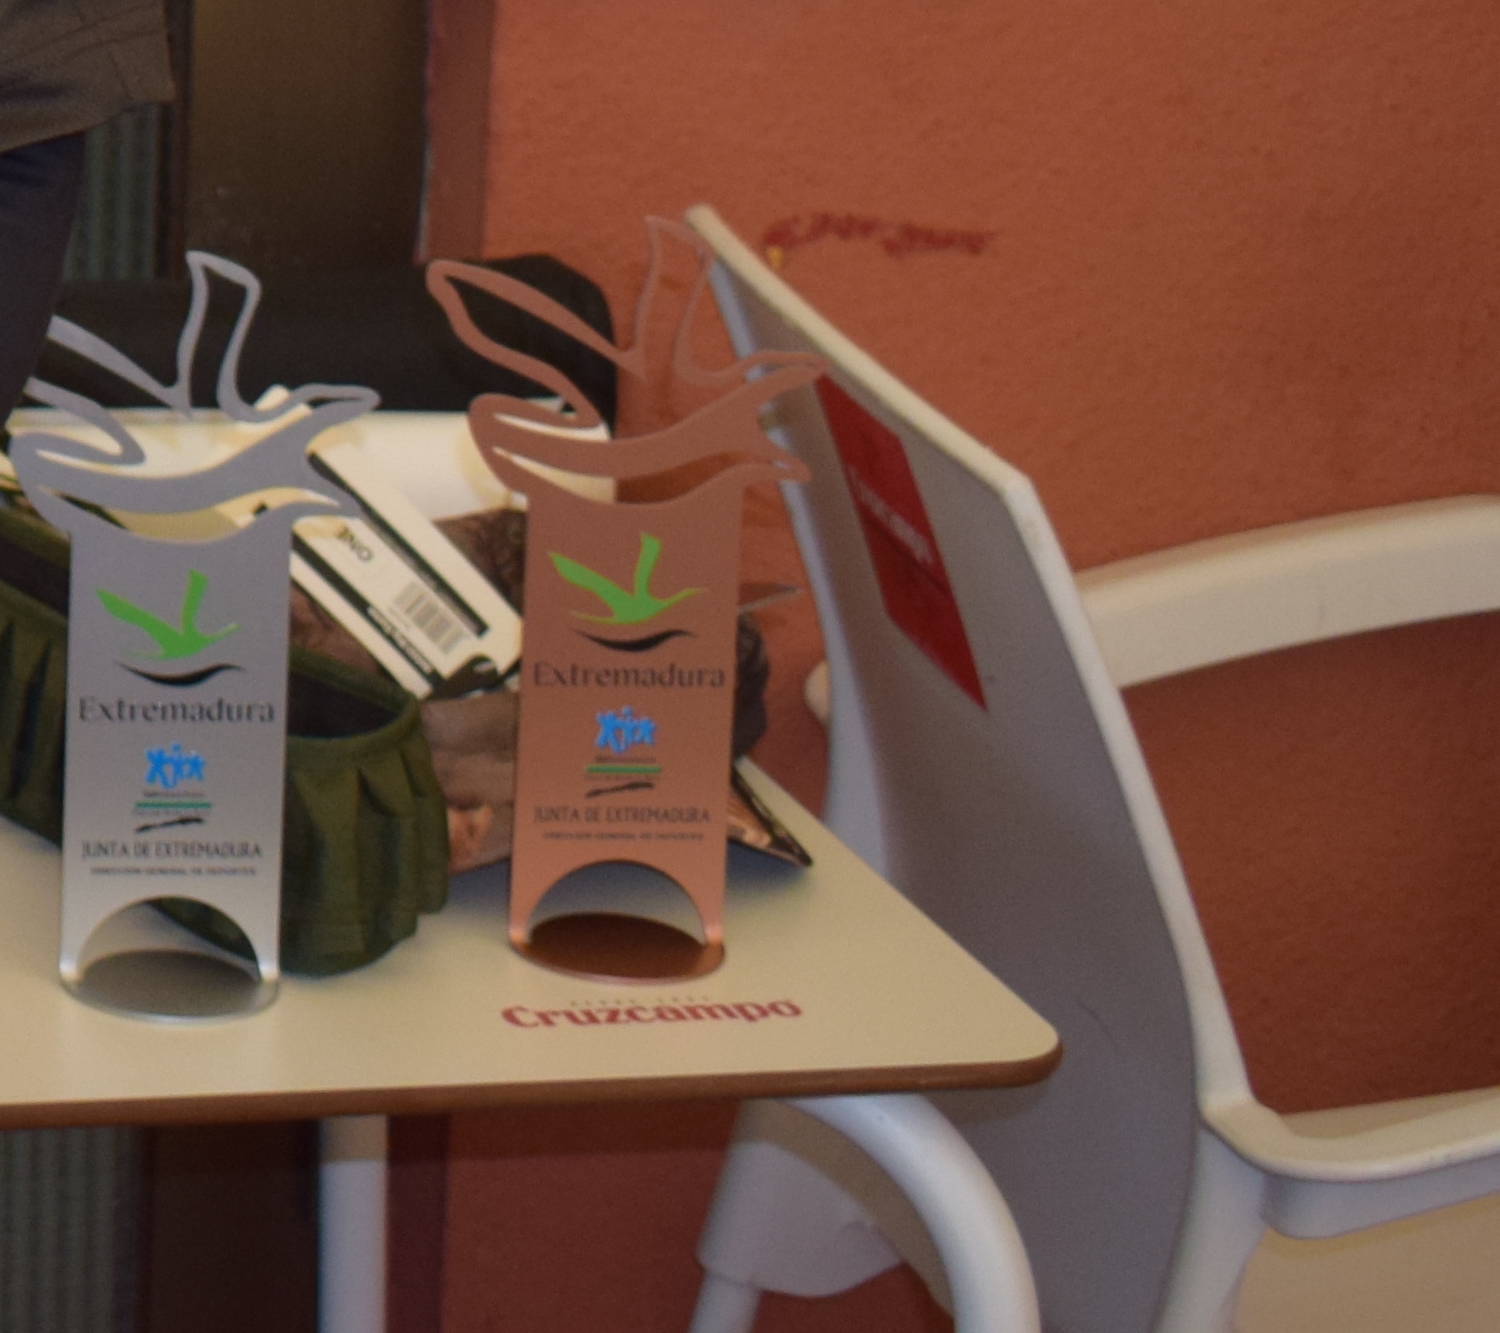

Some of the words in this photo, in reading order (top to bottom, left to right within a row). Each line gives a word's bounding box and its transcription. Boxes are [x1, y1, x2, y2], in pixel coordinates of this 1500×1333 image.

[533, 661, 725, 688] Extremadura
[79, 697, 276, 723] Extremadura
[533, 806, 579, 824] JUNTA
[585, 806, 600, 823] DE
[606, 806, 711, 824] EXTREMADURA
[82, 840, 128, 859] JUNTA
[134, 840, 150, 858] DE
[155, 840, 262, 859] EXTREMADURA
[500, 999, 803, 1029] Cruzcampo
